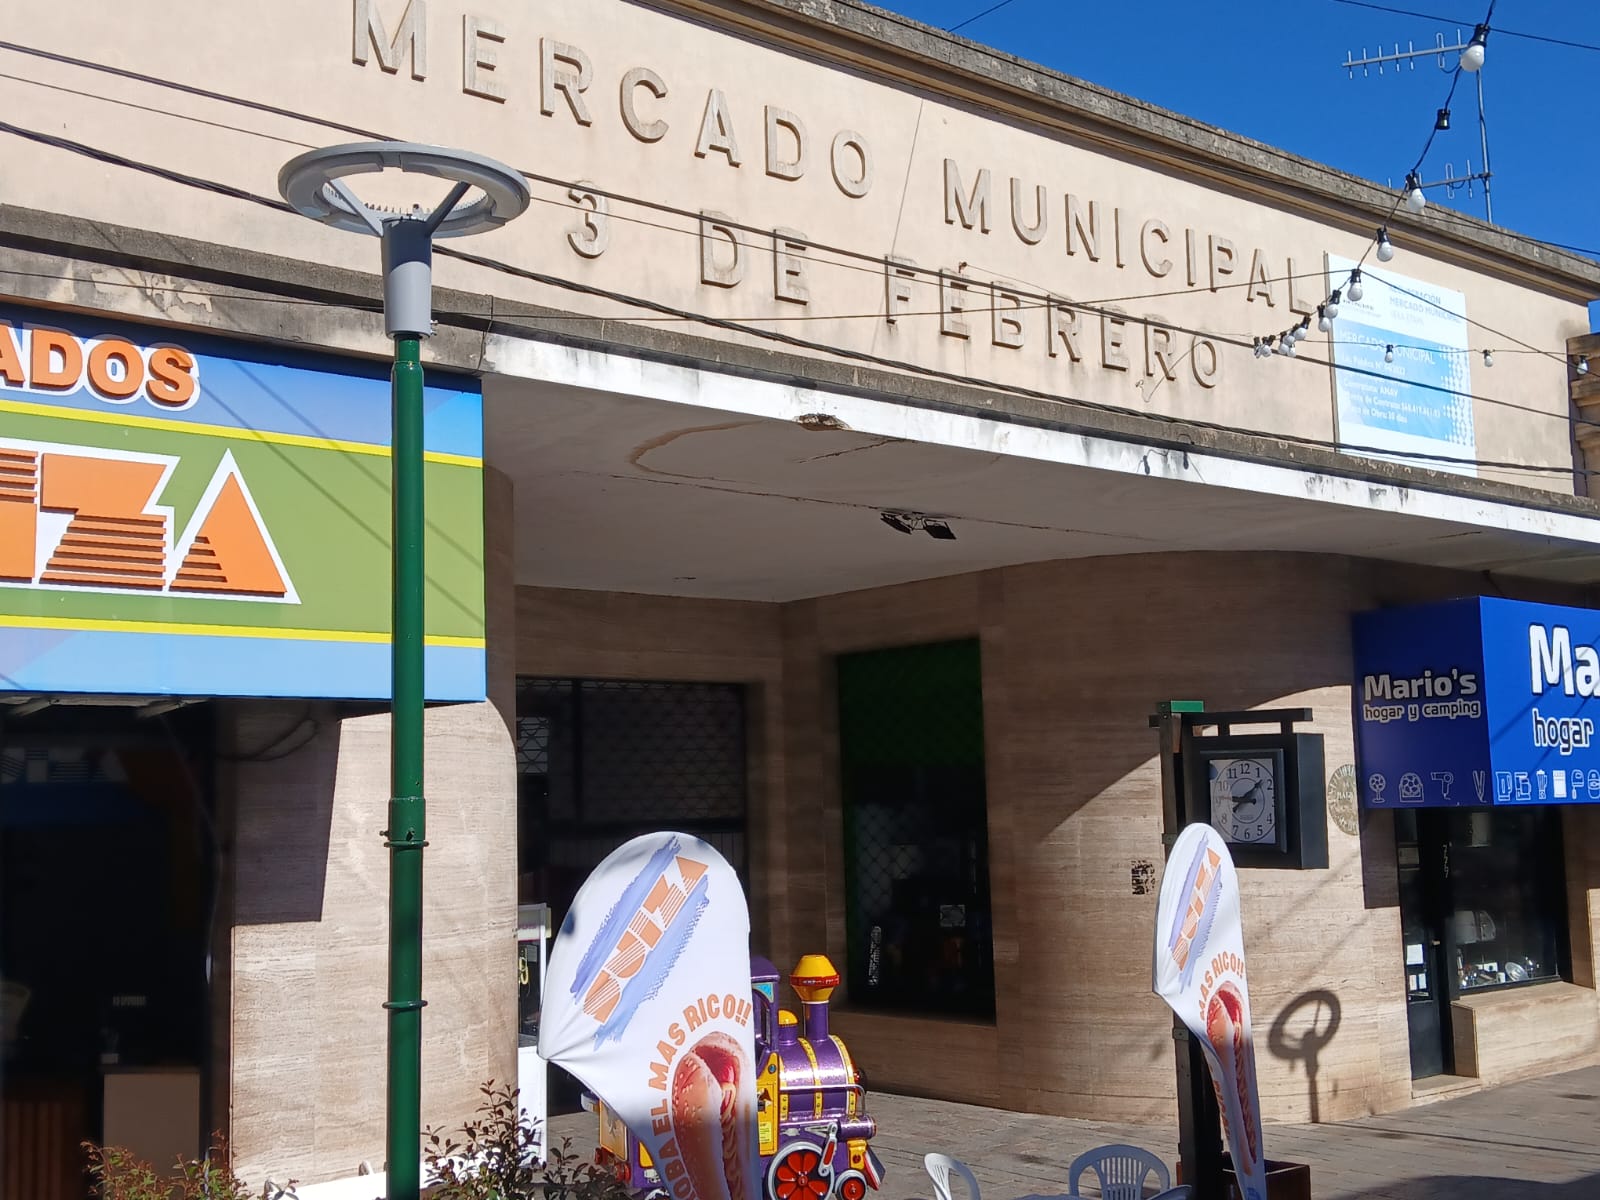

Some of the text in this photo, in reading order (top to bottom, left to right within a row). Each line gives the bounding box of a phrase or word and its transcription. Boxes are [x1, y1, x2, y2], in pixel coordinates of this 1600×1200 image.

[352, 0, 1316, 317] MERCADO MUNICIPAL
[567, 180, 1225, 389] 3 DE FEBRERO
[1364, 669, 1477, 701] Mario's
[1364, 700, 1482, 723] hogar y camping
[1532, 707, 1594, 756] hogar
[1211, 950, 1244, 979] RICO!!
[648, 993, 752, 1200] OBA EL MAS RICO!!
